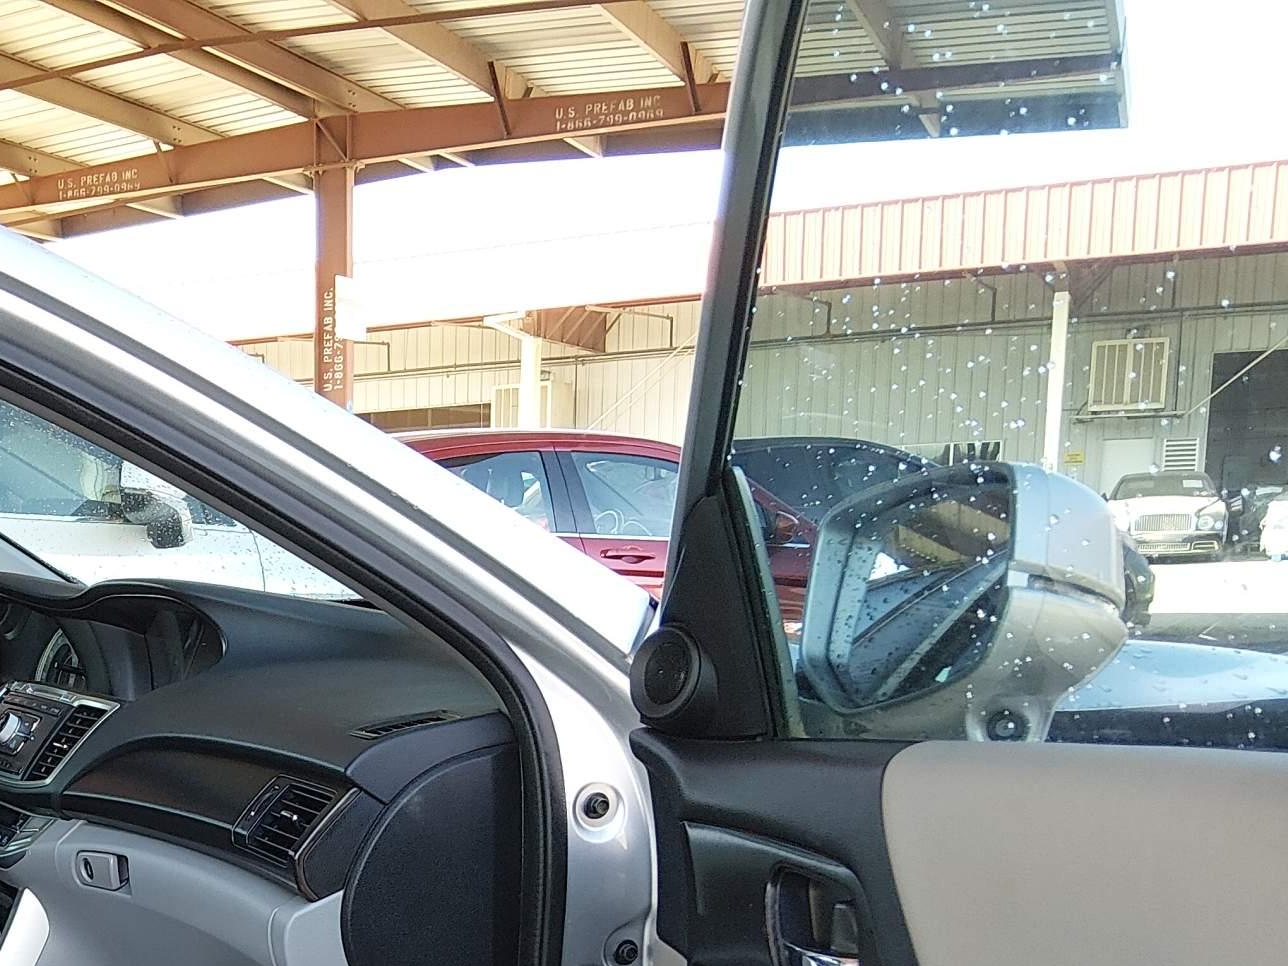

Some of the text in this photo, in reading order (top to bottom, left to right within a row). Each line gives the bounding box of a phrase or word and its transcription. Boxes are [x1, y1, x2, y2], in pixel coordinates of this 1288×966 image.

[585, 98, 634, 115] PREFAB
[80, 171, 118, 187] PREFAB
[323, 288, 334, 392] U.S. PREFAB INC.
